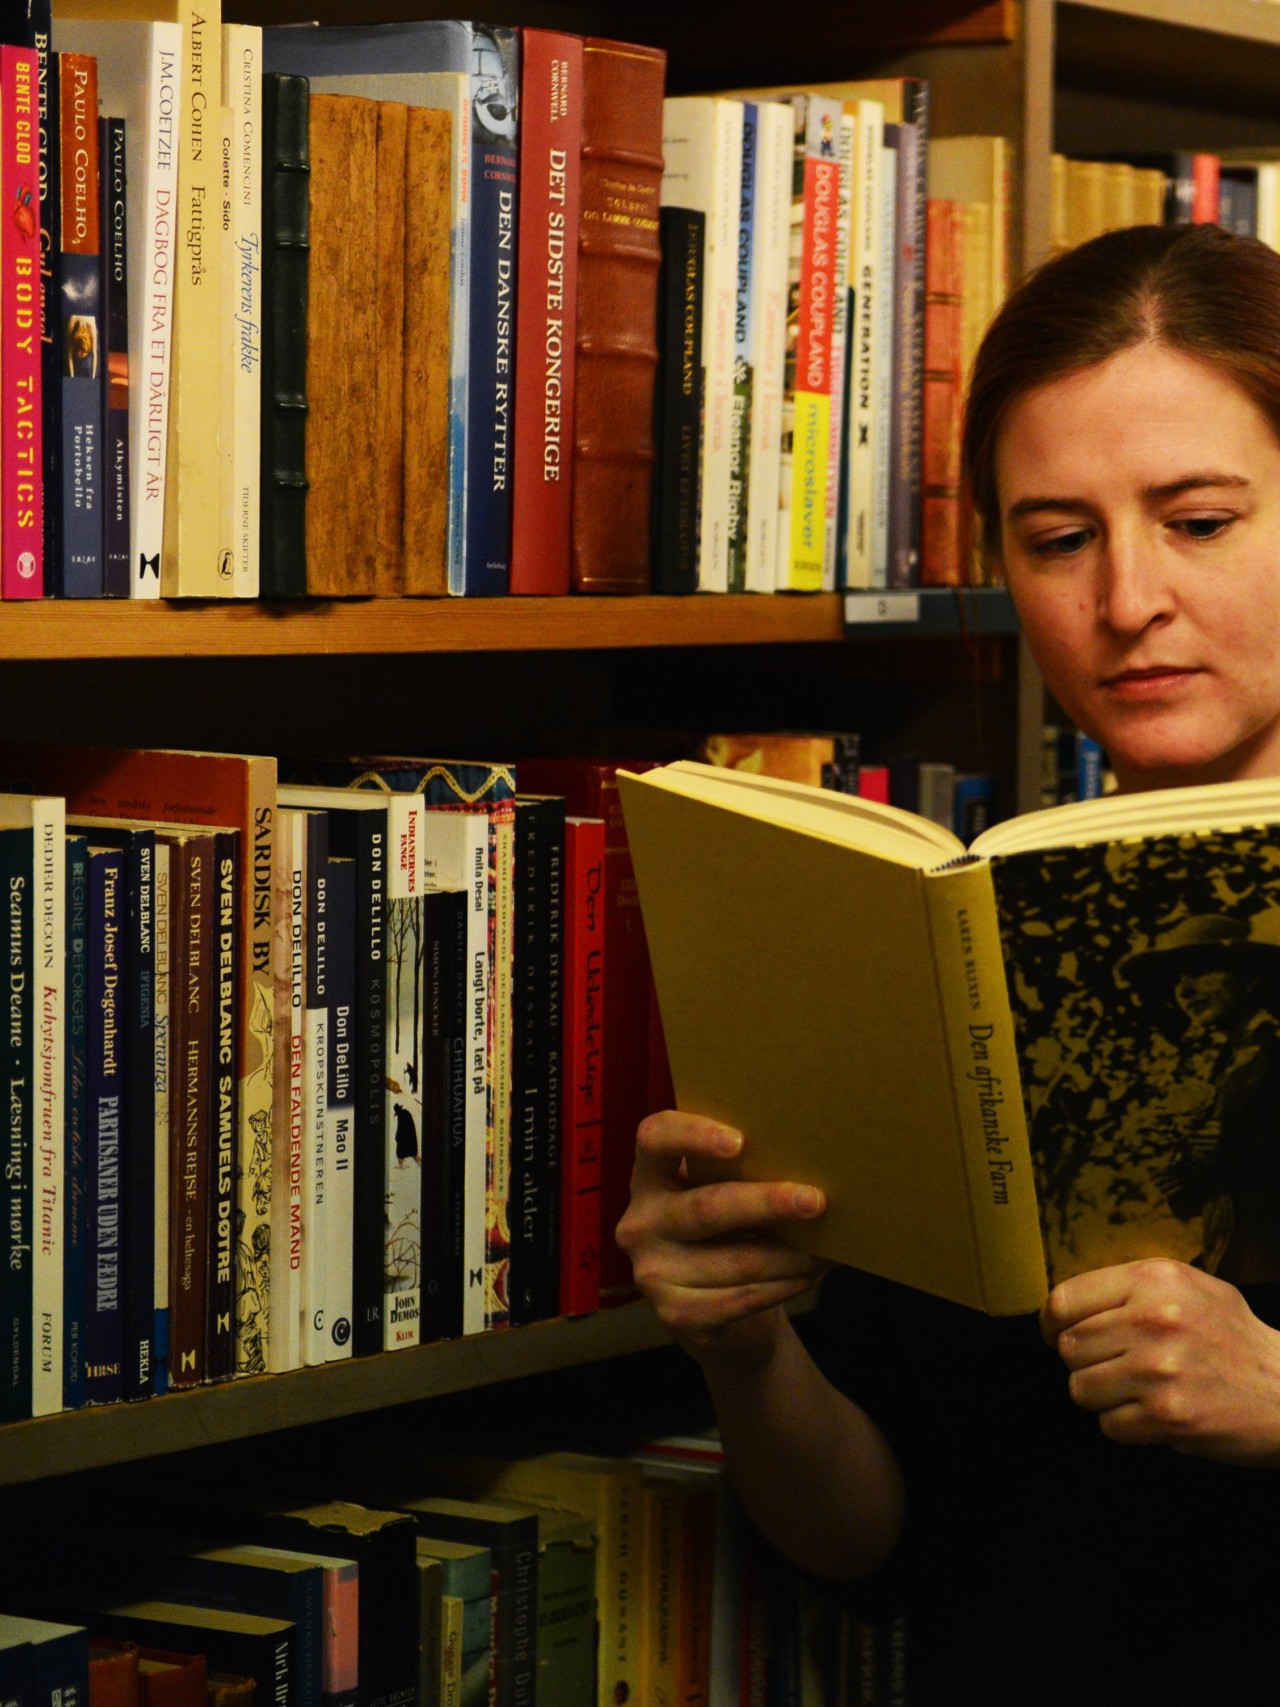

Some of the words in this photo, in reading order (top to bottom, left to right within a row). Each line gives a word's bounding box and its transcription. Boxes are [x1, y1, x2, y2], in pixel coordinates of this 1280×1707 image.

[191, 11, 207, 85] ALBERT
[243, 48, 253, 115] CRISTINA
[16, 62, 30, 115] BENTE
[74, 70, 88, 141] PAULO
[560, 61, 569, 118] BERNARD
[16, 120, 31, 164] CLOD
[113, 128, 123, 193] PAULO
[190, 91, 207, 162] COHEN
[75, 149, 90, 239] COELHO
[222, 137, 231, 188] Colette
[242, 121, 253, 206] COMENCINI
[549, 149, 567, 206] DET
[737, 121, 752, 224] DOUGLAS
[113, 200, 124, 282] COELHO
[153, 189, 171, 287] DAGBOG
[187, 185, 207, 287] Fattigprås
[222, 200, 231, 231] Sido
[498, 190, 512, 250] DEN
[811, 163, 833, 267] DOUGLAS
[235, 232, 260, 314] Tyrkerens
[546, 212, 565, 311] SIDSTE
[734, 228, 749, 344] COUPLAND
[16, 257, 33, 354] BODY
[152, 293, 166, 333] FRA
[496, 259, 511, 374] DANSKE
[807, 271, 828, 388] COUPLAND
[859, 265, 872, 410] GENERATION
[150, 339, 165, 361] ET
[235, 313, 260, 375] frakke
[682, 305, 696, 396] COUPLAND
[147, 371, 166, 468] DÅRLIGT
[543, 318, 563, 482] KONGERIGE
[16, 376, 34, 528] TACTICS
[74, 425, 83, 509] Portobello
[85, 424, 94, 485] Heksen
[493, 382, 509, 493] RYTTER
[729, 395, 745, 477] Eleanor
[857, 422, 868, 449] X
[85, 487, 94, 510] fra
[115, 439, 124, 521] Alkymisten
[146, 471, 164, 503] ÅR
[241, 486, 249, 532] TIDERNE
[802, 402, 819, 548] microslaver
[727, 480, 743, 541] Rigby
[241, 533, 249, 574] SKIFTER
[140, 848, 150, 882] SVEN
[188, 855, 201, 908] SVEN
[252, 807, 273, 930] SARDISK
[370, 833, 382, 872] DON
[400, 833, 408, 871] FANGE
[407, 810, 418, 893] INDIANERNES
[474, 847, 484, 879] Anita
[526, 815, 536, 945] FREDERIK
[9, 875, 25, 967] Seamus
[104, 867, 118, 918] Franz
[140, 883, 150, 953] DELBLANC
[157, 872, 168, 912] SVEN
[220, 858, 233, 927] SVEN
[291, 869, 302, 918] DON
[316, 878, 326, 914] DON
[370, 879, 382, 961] DELILLO
[474, 880, 484, 913] Desai
[550, 846, 559, 944] FREDERIK
[586, 861, 602, 933] Den
[43, 898, 54, 969] DECOIN
[104, 921, 118, 970] Josef
[157, 914, 168, 1005] DELBLANC
[188, 914, 200, 1014] DELBLANC
[252, 940, 271, 977] BY
[316, 921, 326, 996] DELILLO
[431, 939, 440, 980] SIMON
[957, 908, 973, 953] KAREN
[71, 938, 85, 1036] DEFORGES
[139, 970, 150, 1029] IFIGENIA
[219, 932, 233, 1065] DELBLANC
[291, 923, 302, 1009] DELILLO
[473, 950, 486, 992] Langt
[549, 953, 559, 1028] DESSAU
[963, 955, 981, 1010] BLIXEN
[9, 972, 25, 1048] Deane
[101, 973, 118, 1077] Degenhardt
[336, 1006, 350, 1038] Don
[472, 993, 484, 1041] borte,
[968, 1023, 995, 1061] Den
[155, 1013, 169, 1093] Speranza
[290, 1035, 301, 1078] DEN
[336, 1043, 349, 1100] DeLillo
[369, 979, 381, 1125] KOSMOPOLIS
[471, 1076, 485, 1095] på
[472, 1047, 485, 1074] tæt
[186, 1039, 199, 1148] HERMANNS
[315, 1023, 325, 1205] KROPSKUNSTNEREN
[965, 1064, 1010, 1156] afrikanske
[5, 1078, 28, 1180] Læsning
[40, 1145, 57, 1179] fra
[97, 1096, 119, 1201] PARTISANER
[217, 1075, 232, 1196] SAMUELS
[290, 1087, 301, 1195] FALDENDE
[336, 1118, 349, 1153] Mao
[523, 1105, 538, 1161] min
[185, 1152, 197, 1201] REJSE
[335, 1157, 348, 1171] II
[988, 1156, 1014, 1206] Farm
[10, 1197, 30, 1271] mørke
[41, 1184, 57, 1256] Titanic
[97, 1202, 118, 1248] UDEN
[289, 1204, 300, 1270] MAND
[523, 1172, 538, 1243] alder
[217, 1201, 230, 1285] DØTRE
[96, 1251, 118, 1313] FÆDRE
[393, 1295, 416, 1312] JOHN
[41, 1312, 52, 1373] FORUM
[70, 1321, 79, 1340] PER
[390, 1308, 420, 1326] DEMOS
[395, 1330, 414, 1343] KLIM
[12, 1317, 20, 1389] GYLDENDAL
[69, 1342, 79, 1383] KOFOD
[139, 1339, 149, 1385] HEKLA
[513, 1550, 532, 1663] Christophe
[449, 1631, 458, 1679] Gustave
